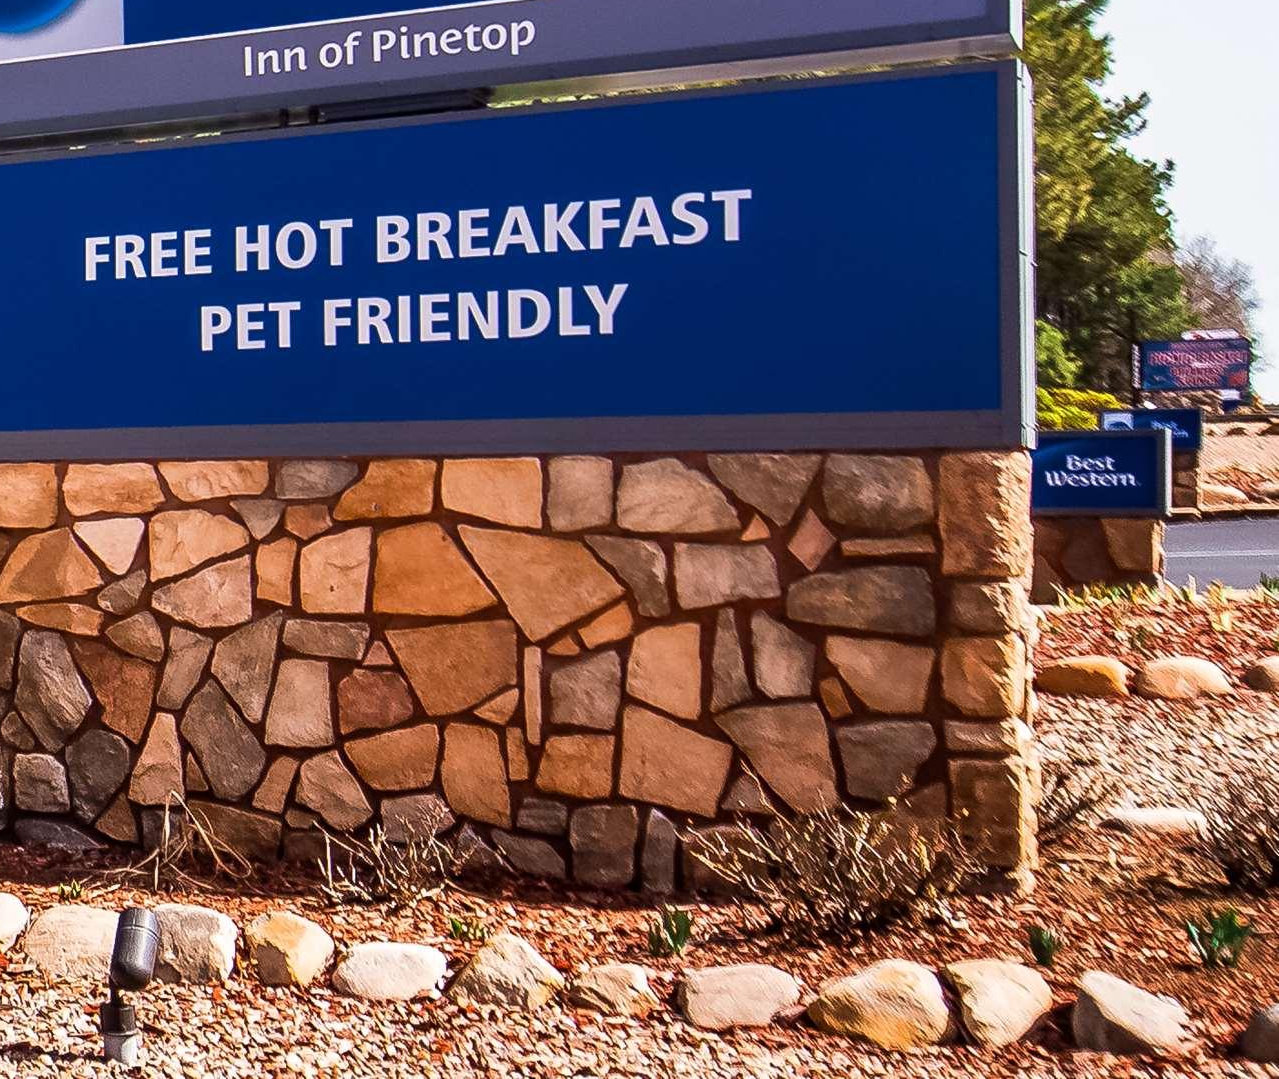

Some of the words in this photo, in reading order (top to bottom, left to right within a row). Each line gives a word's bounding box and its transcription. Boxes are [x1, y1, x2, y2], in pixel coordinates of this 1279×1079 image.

[243, 45, 309, 77] Inn
[318, 30, 363, 69] of
[372, 19, 537, 63] Pinetop
[84, 227, 213, 282] FREE
[234, 217, 354, 273] HOT
[375, 188, 753, 264] BREAKFAST
[199, 300, 302, 353] PET
[322, 282, 630, 347] FRIENDLY
[1044, 471, 1137, 487] Western
[1065, 454, 1115, 471] Best
